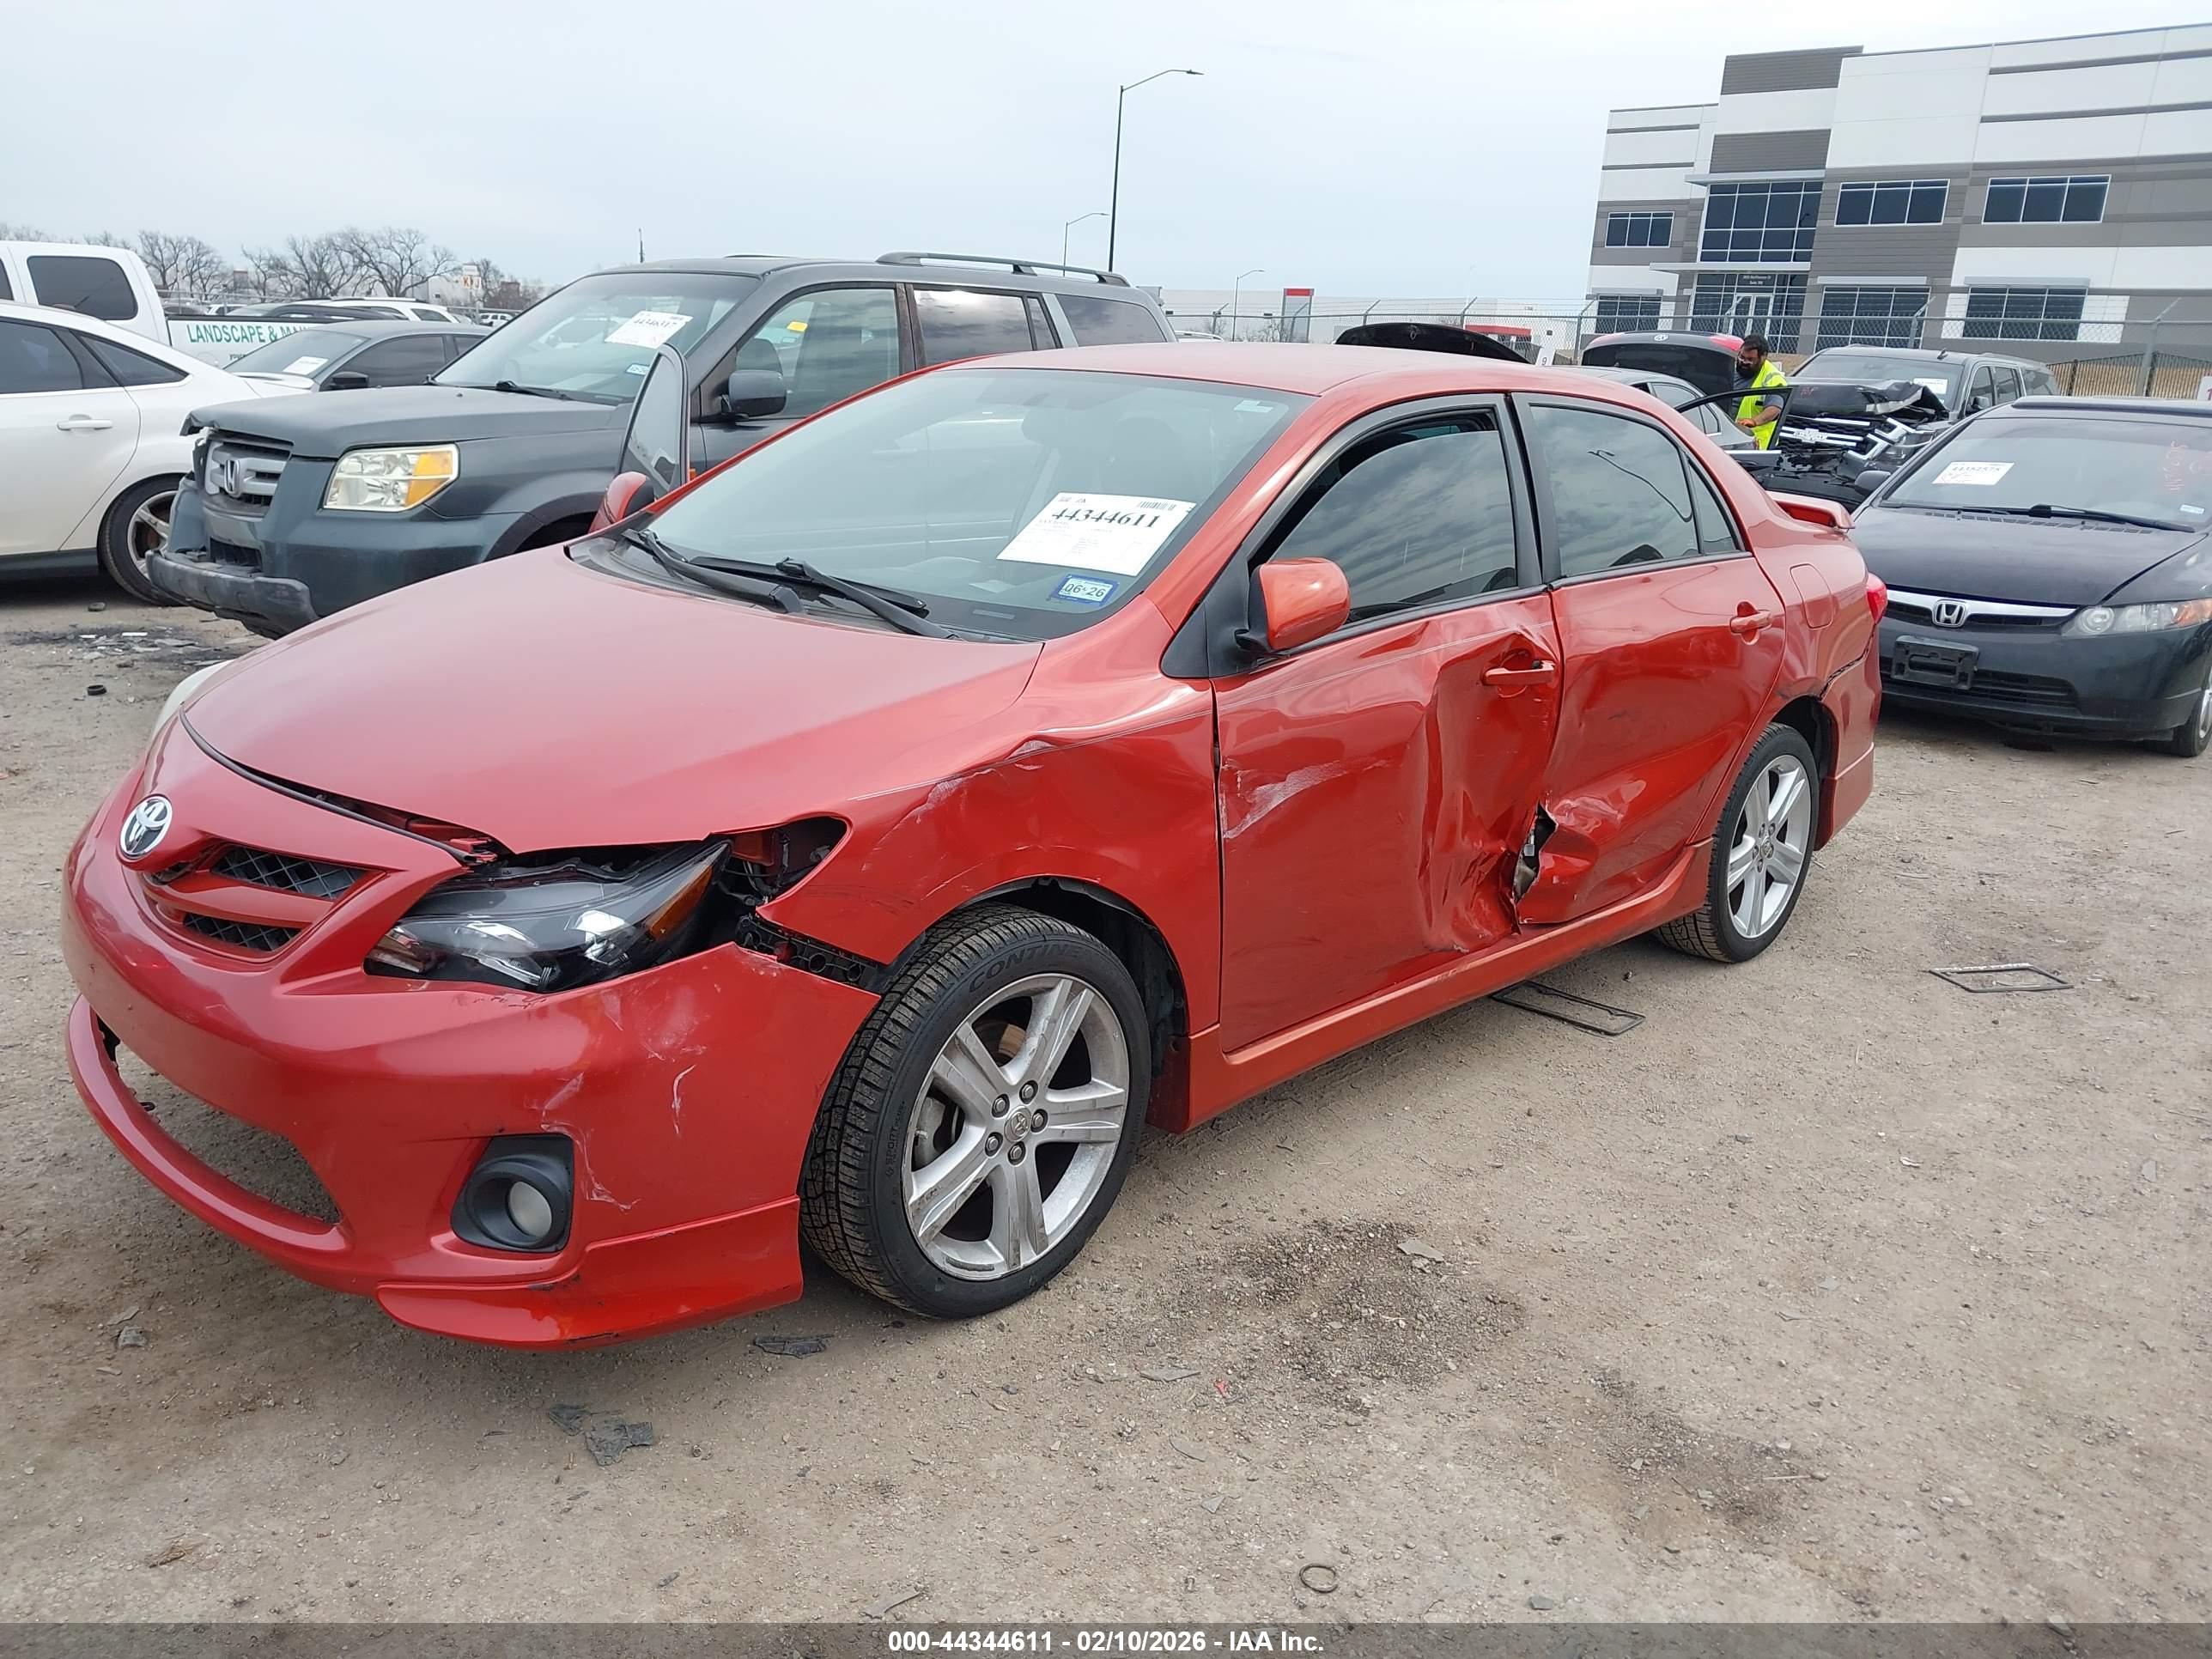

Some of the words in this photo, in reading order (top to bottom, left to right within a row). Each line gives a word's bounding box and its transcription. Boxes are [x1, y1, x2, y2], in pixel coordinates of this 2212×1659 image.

[186, 324, 266, 343] LANDSCAPE
[268, 325, 278, 343] &
[1052, 508, 1161, 528] 44344611
